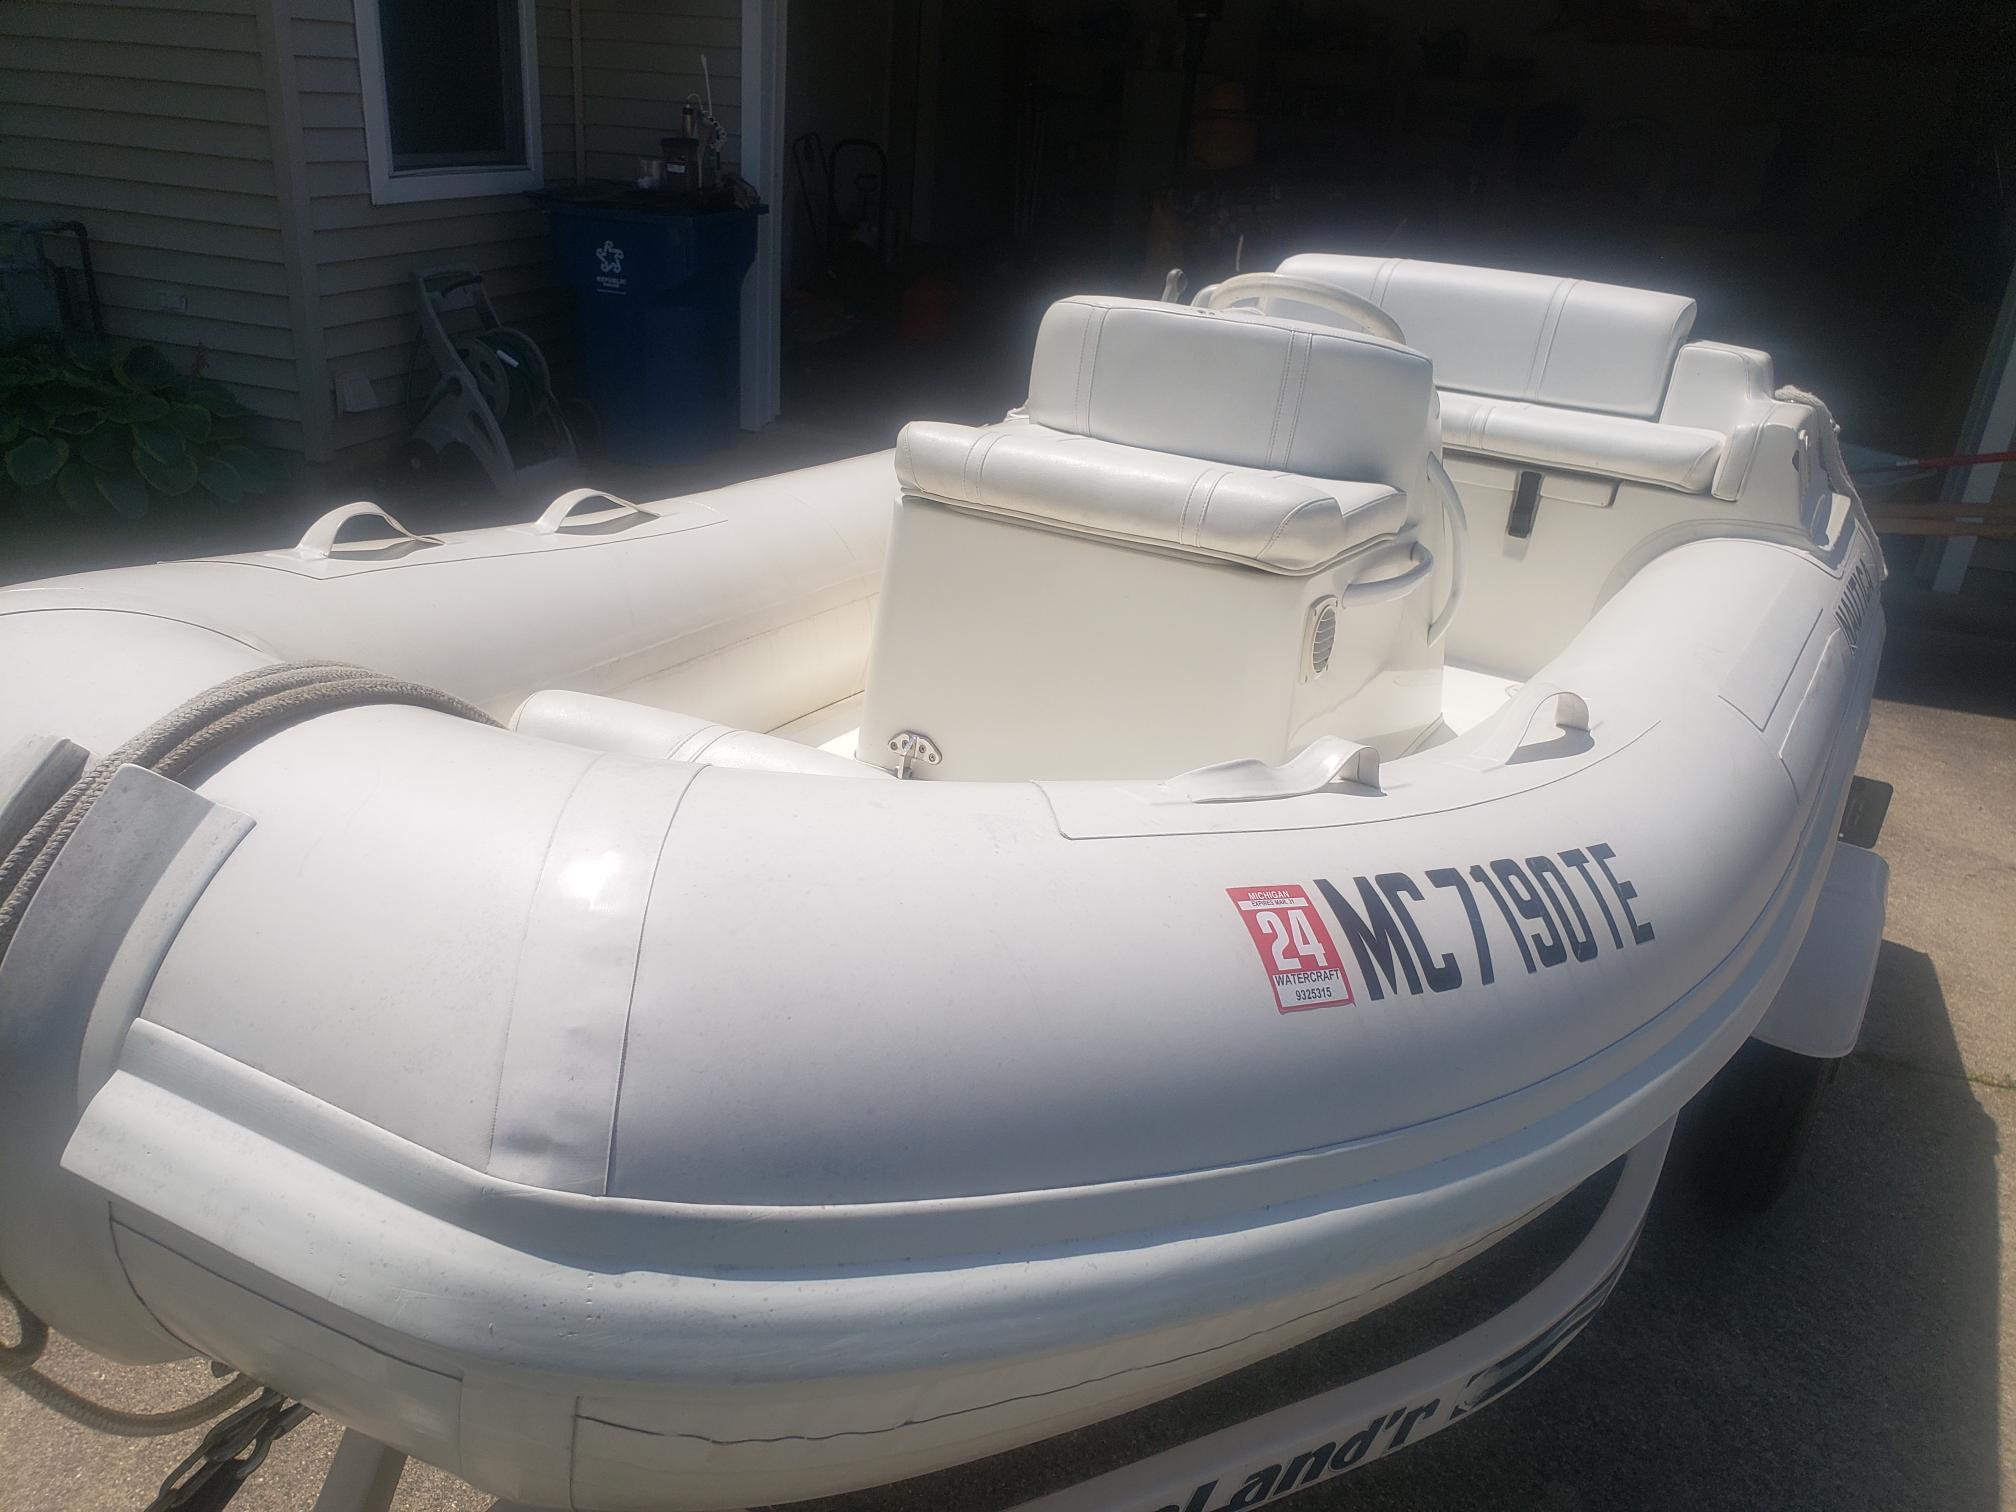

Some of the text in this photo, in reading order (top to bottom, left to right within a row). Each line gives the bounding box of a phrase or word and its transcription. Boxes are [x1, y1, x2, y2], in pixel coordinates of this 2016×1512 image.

[1248, 890, 1290, 901] MICHIGAN
[1251, 899, 1275, 907] EXPIRES
[1256, 910, 1328, 971] 24
[1275, 969, 1340, 987] WATERCRAFT
[1295, 987, 1332, 1002] 9325315
